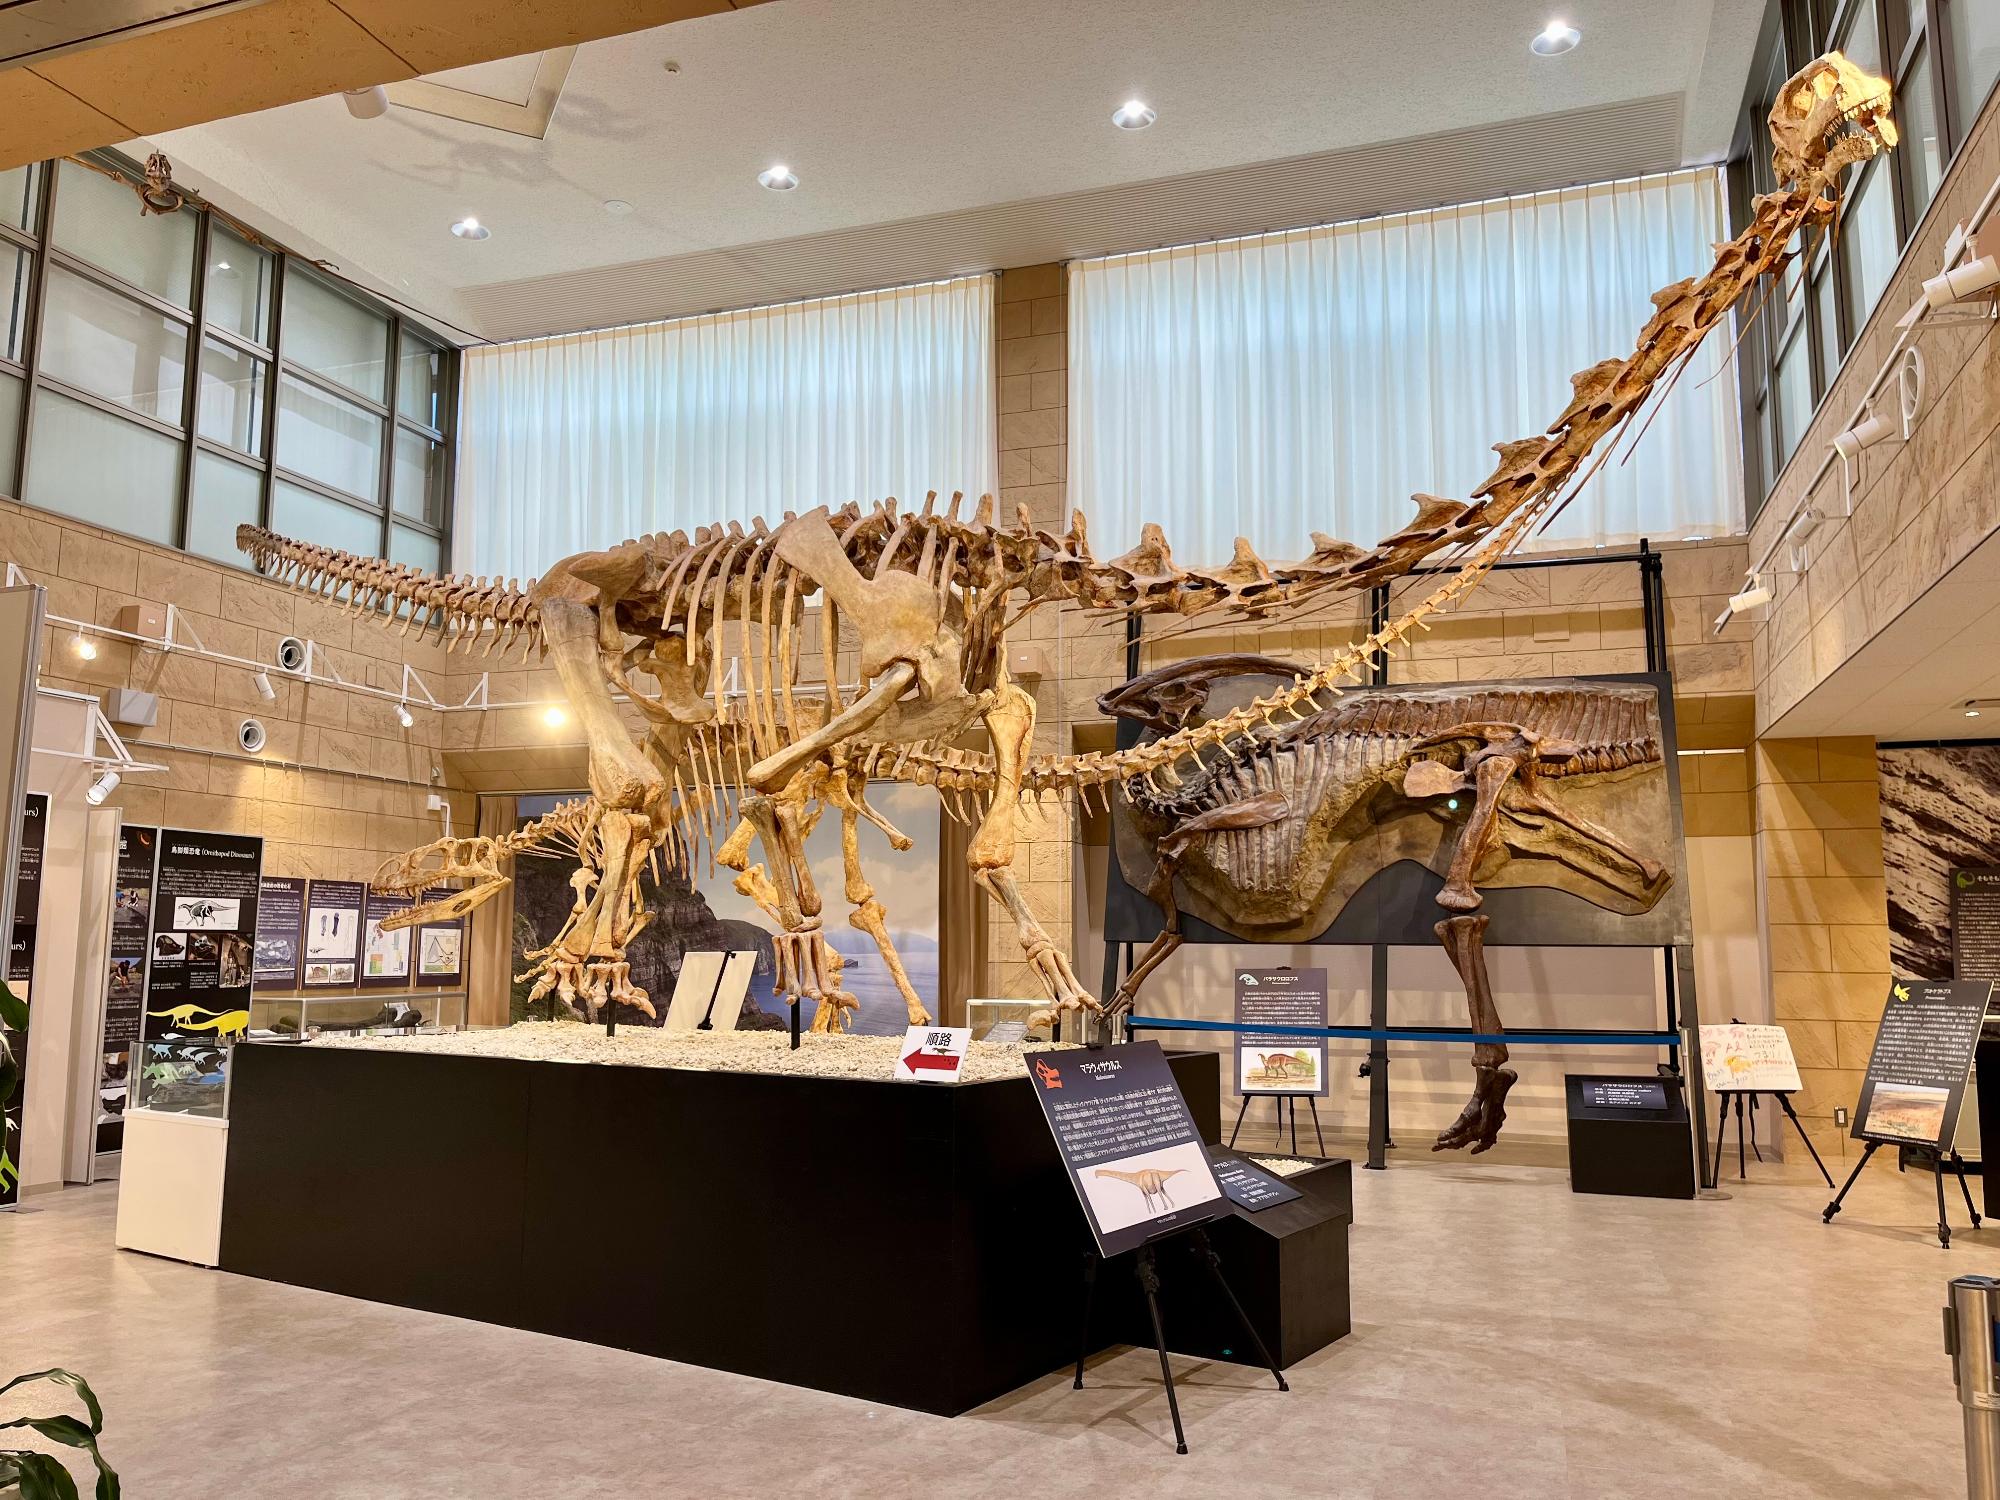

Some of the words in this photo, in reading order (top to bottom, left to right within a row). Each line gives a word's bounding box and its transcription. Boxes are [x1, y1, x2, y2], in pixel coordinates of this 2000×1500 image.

[925, 1032, 952, 1047] 順路
[1079, 1060, 1123, 1074] マラウィサウルス
